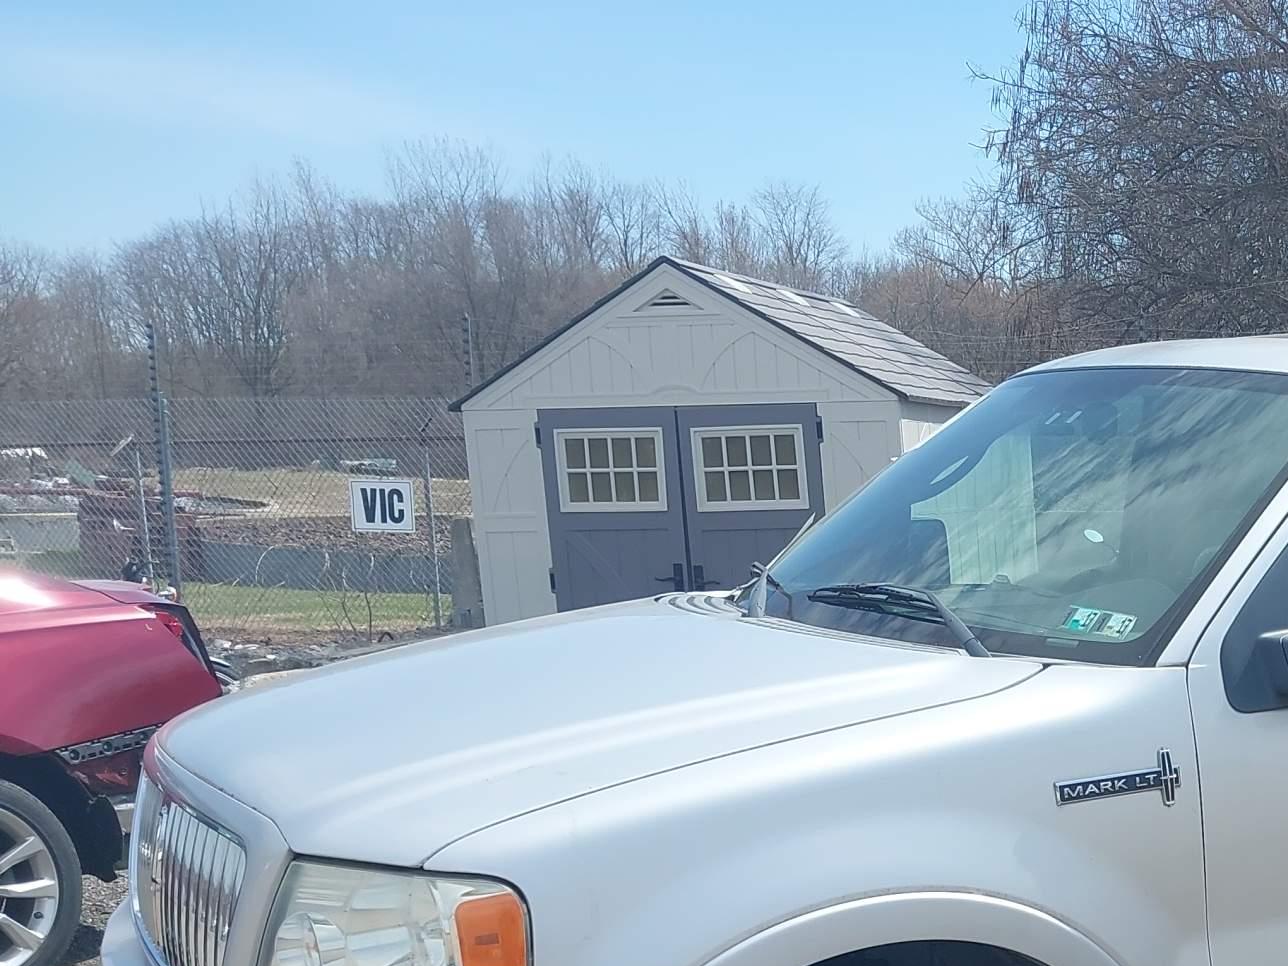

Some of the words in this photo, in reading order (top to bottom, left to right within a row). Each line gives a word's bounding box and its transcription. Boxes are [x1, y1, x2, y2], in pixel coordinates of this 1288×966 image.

[360, 488, 405, 524] VIC
[1063, 778, 1129, 799] MARK
[1135, 773, 1158, 788] LT
